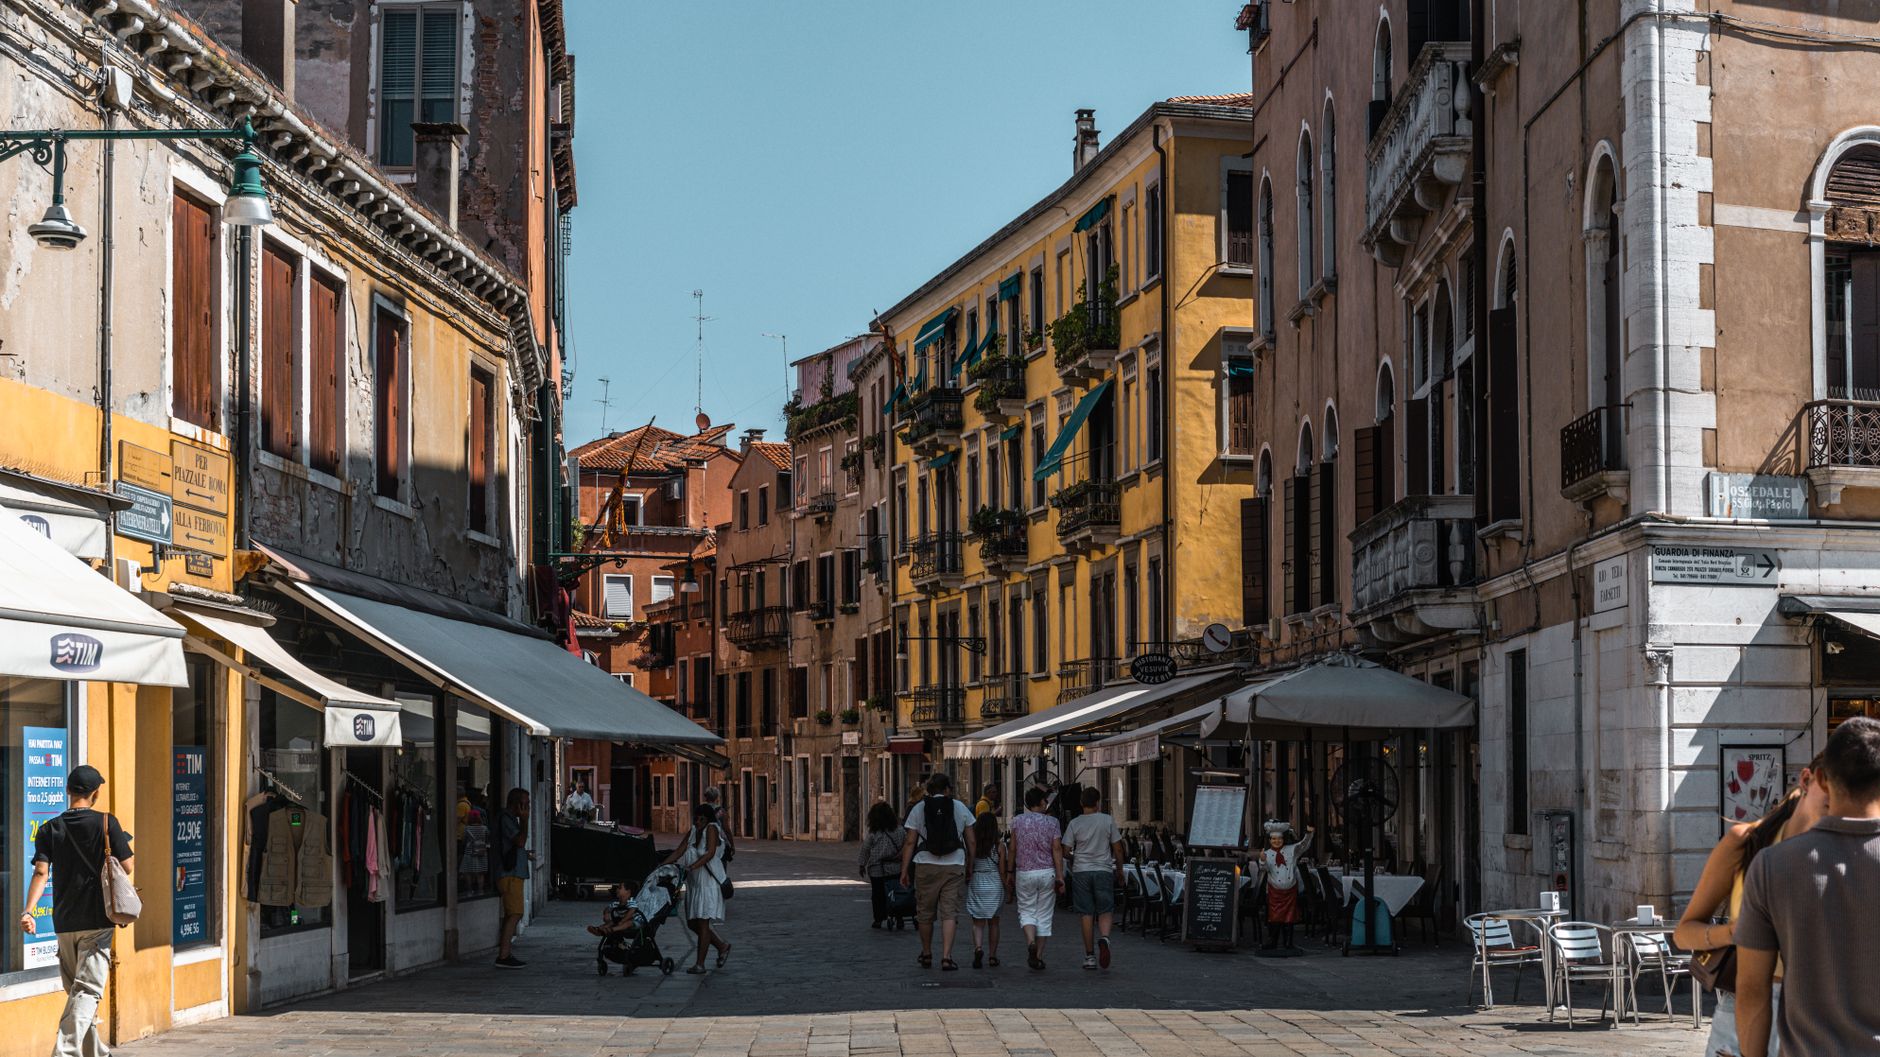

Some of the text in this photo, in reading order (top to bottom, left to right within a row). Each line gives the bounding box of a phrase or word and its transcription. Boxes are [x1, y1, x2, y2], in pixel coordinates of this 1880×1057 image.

[195, 454, 208, 470] PER
[174, 466, 206, 489] PIAZZALE
[208, 476, 226, 495] ROMA
[174, 511, 226, 538] ALLA FERROVIA
[1654, 547, 1734, 558] GUARDIA DI FINANZA
[74, 641, 98, 666] TIM
[1135, 655, 1174, 668] RISTORANTE
[1139, 665, 1169, 673] VESUVIO
[1135, 671, 1174, 684] PIZZERIA
[363, 719, 373, 735] TIM
[37, 739, 53, 749] PARTITA
[51, 754, 63, 767] TIM
[186, 753, 203, 774] TIM
[1748, 753, 1771, 761] SPRITZ
[28, 776, 64, 788] INTERNET FTTH
[27, 791, 37, 803] fino
[49, 791, 65, 806] gigabit
[177, 820, 202, 844] 22,90€
